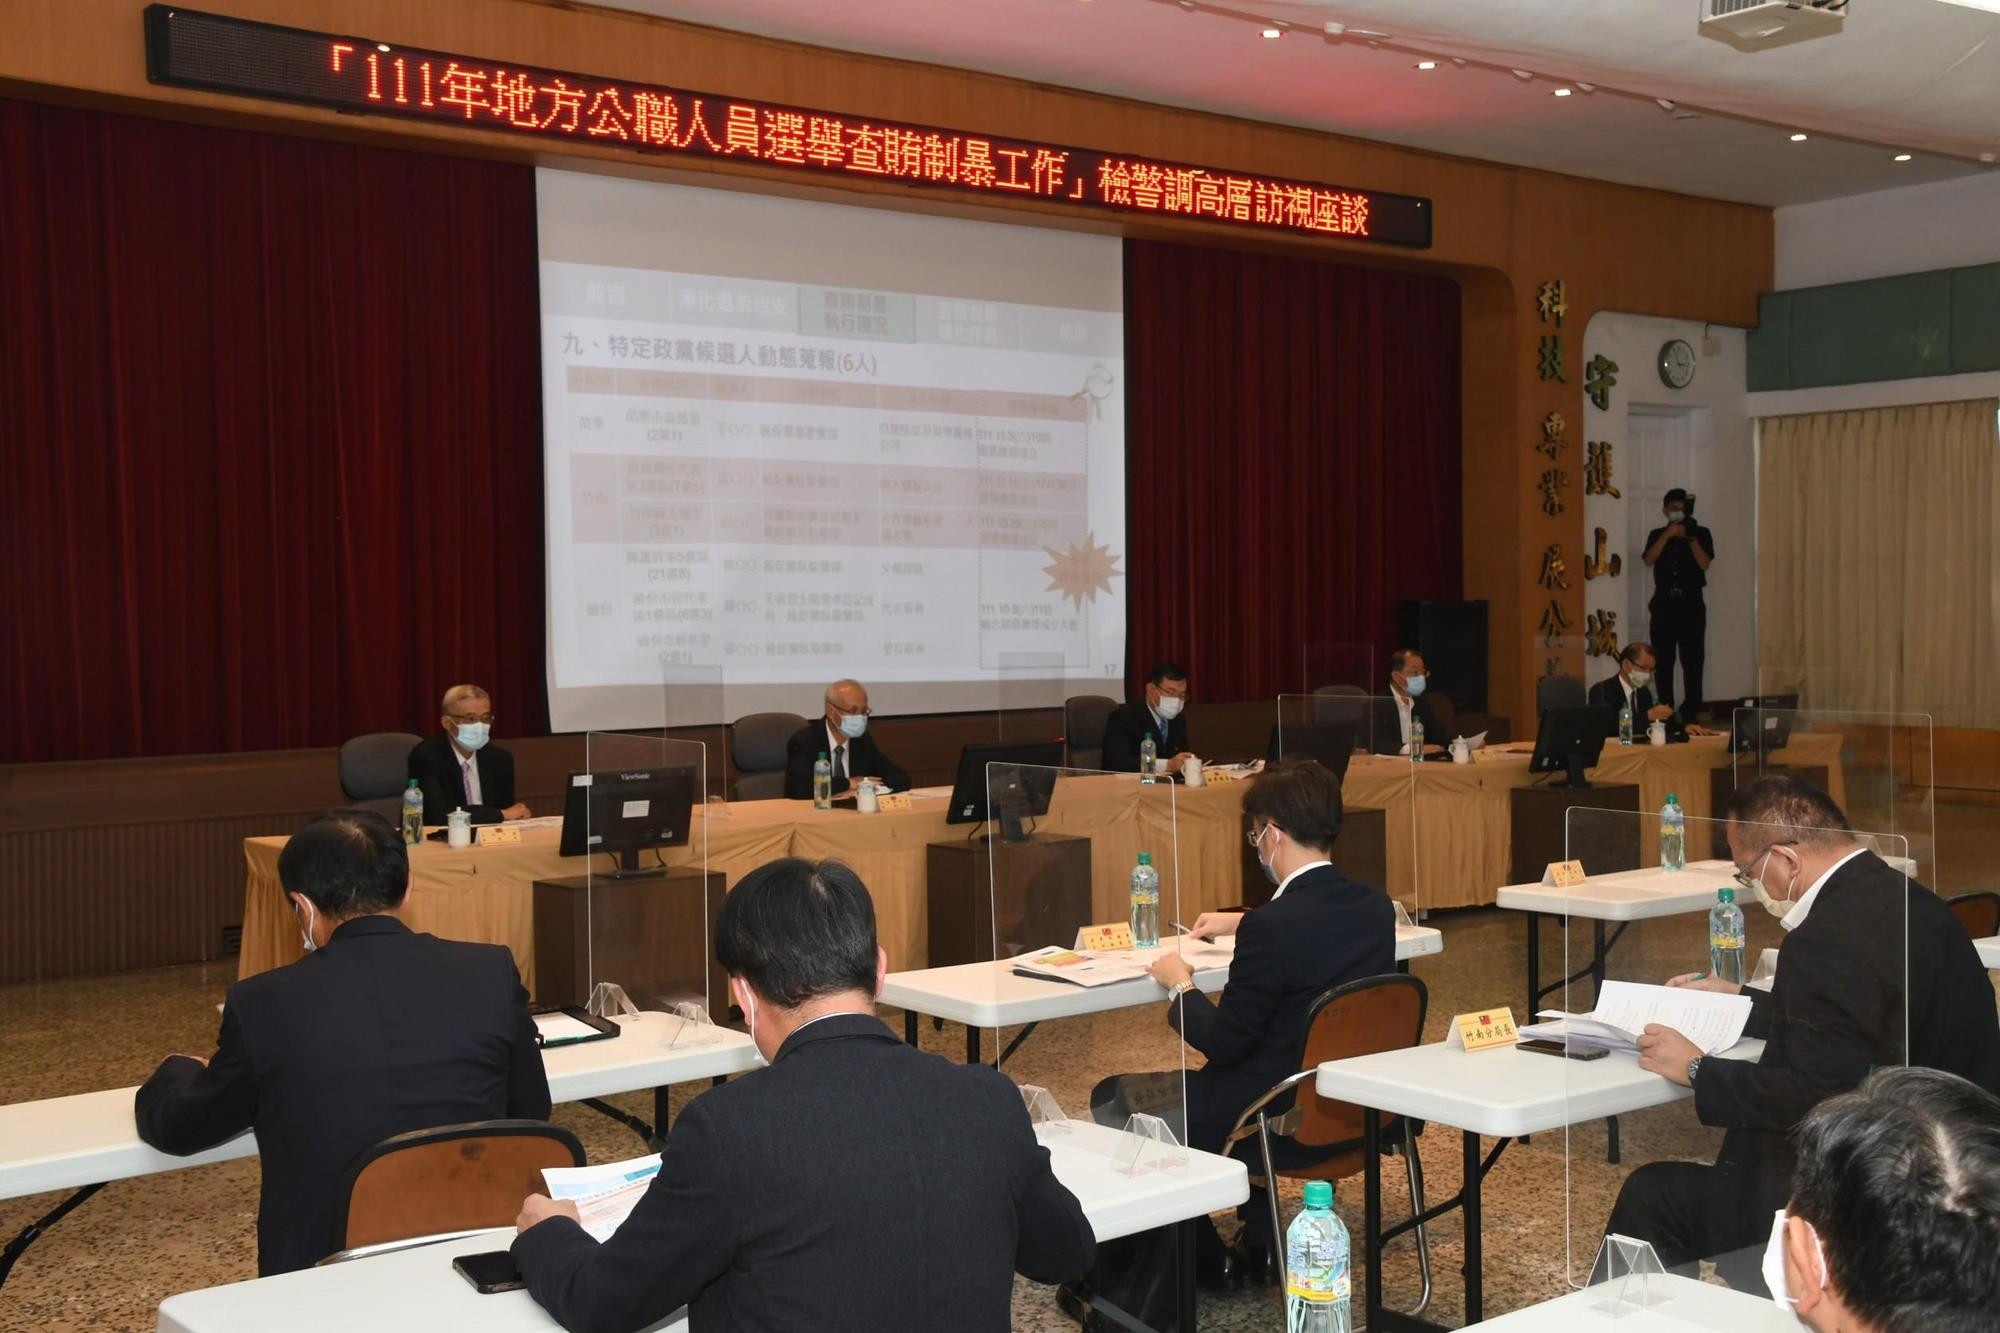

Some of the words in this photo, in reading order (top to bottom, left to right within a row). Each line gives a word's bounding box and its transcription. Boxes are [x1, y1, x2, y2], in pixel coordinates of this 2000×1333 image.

[1103, 663, 1117, 677] 17
[1465, 1023, 1513, 1042] 竹南分局長
